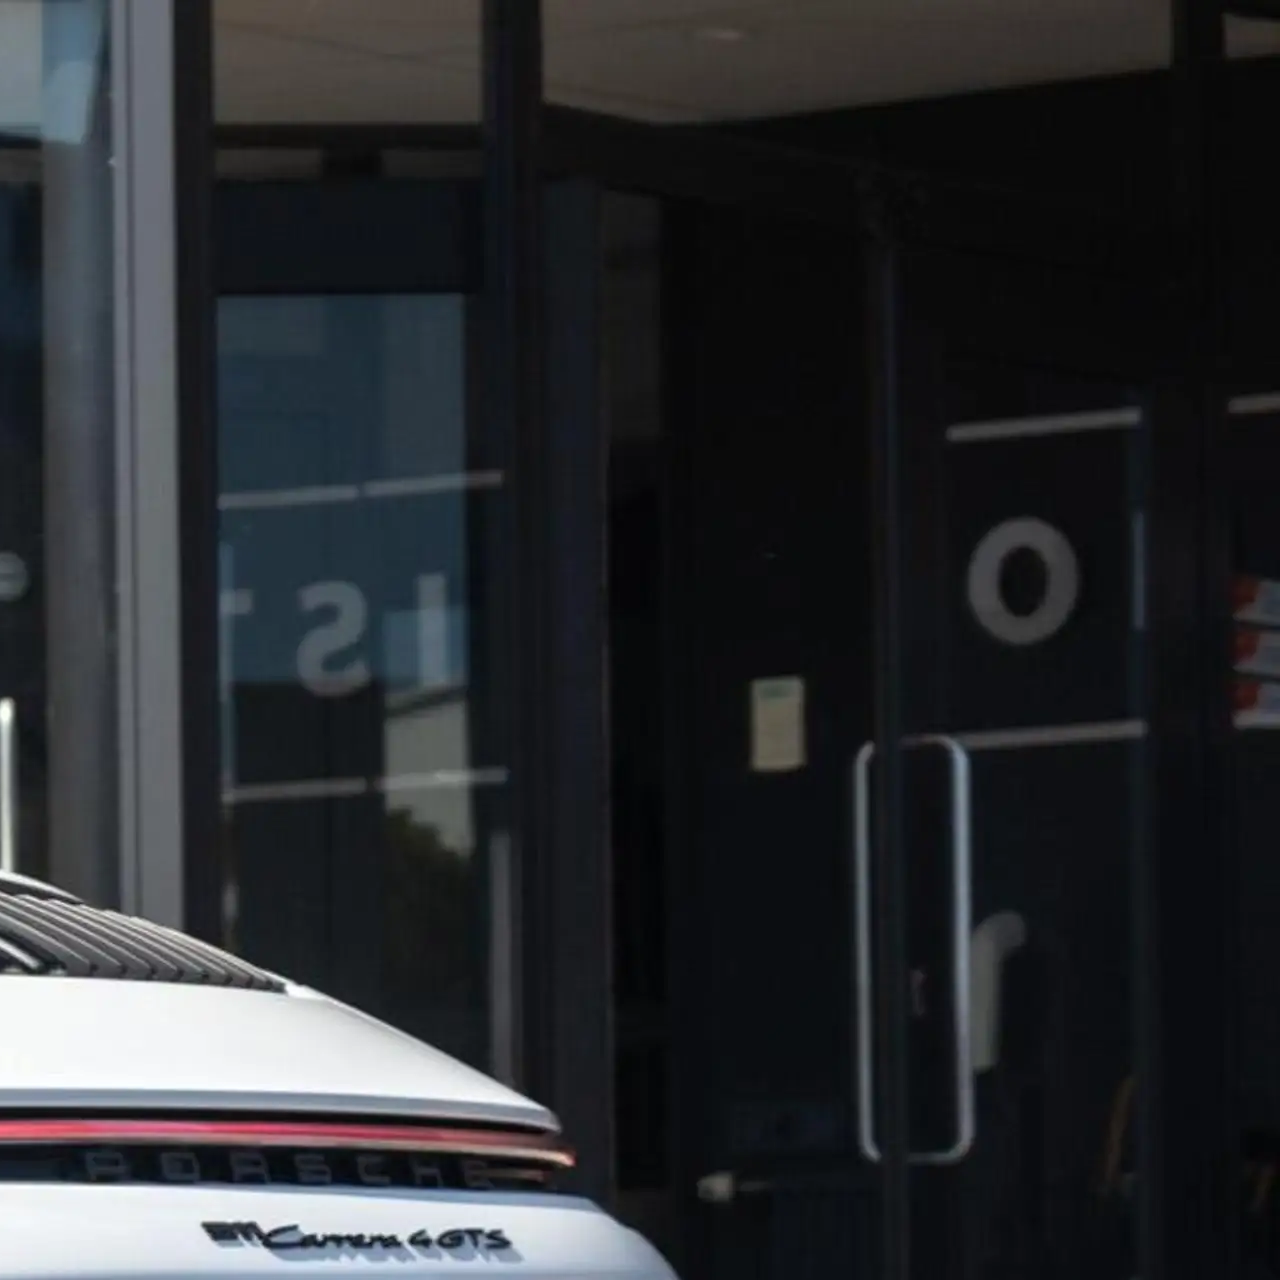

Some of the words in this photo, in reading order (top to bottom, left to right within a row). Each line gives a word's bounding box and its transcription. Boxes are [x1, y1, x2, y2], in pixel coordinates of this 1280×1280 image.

[83, 1147, 495, 1190] PORSCHE
[262, 1223, 403, 1249] Carrera
[436, 1228, 512, 1249] GTS
